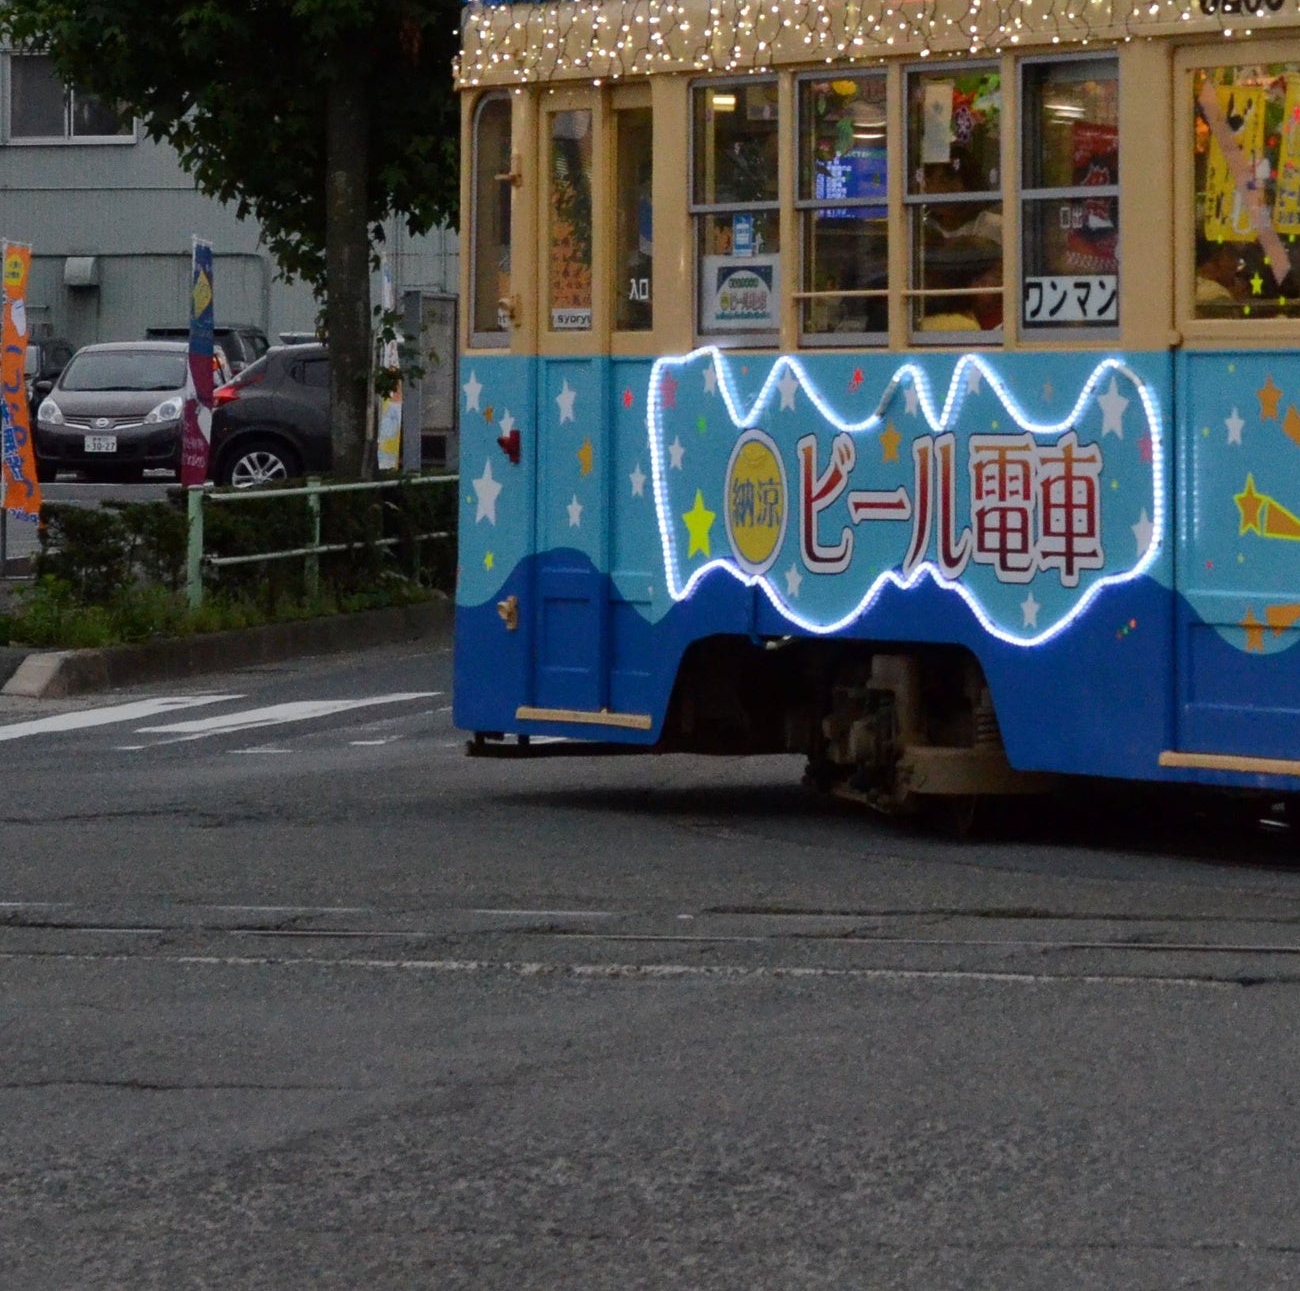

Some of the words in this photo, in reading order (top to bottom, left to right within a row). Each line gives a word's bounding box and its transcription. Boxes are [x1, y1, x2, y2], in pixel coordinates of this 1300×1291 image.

[1024, 281, 1116, 320] ワンマン
[732, 475, 782, 529] 納涼
[799, 433, 1103, 586] ビール電車
